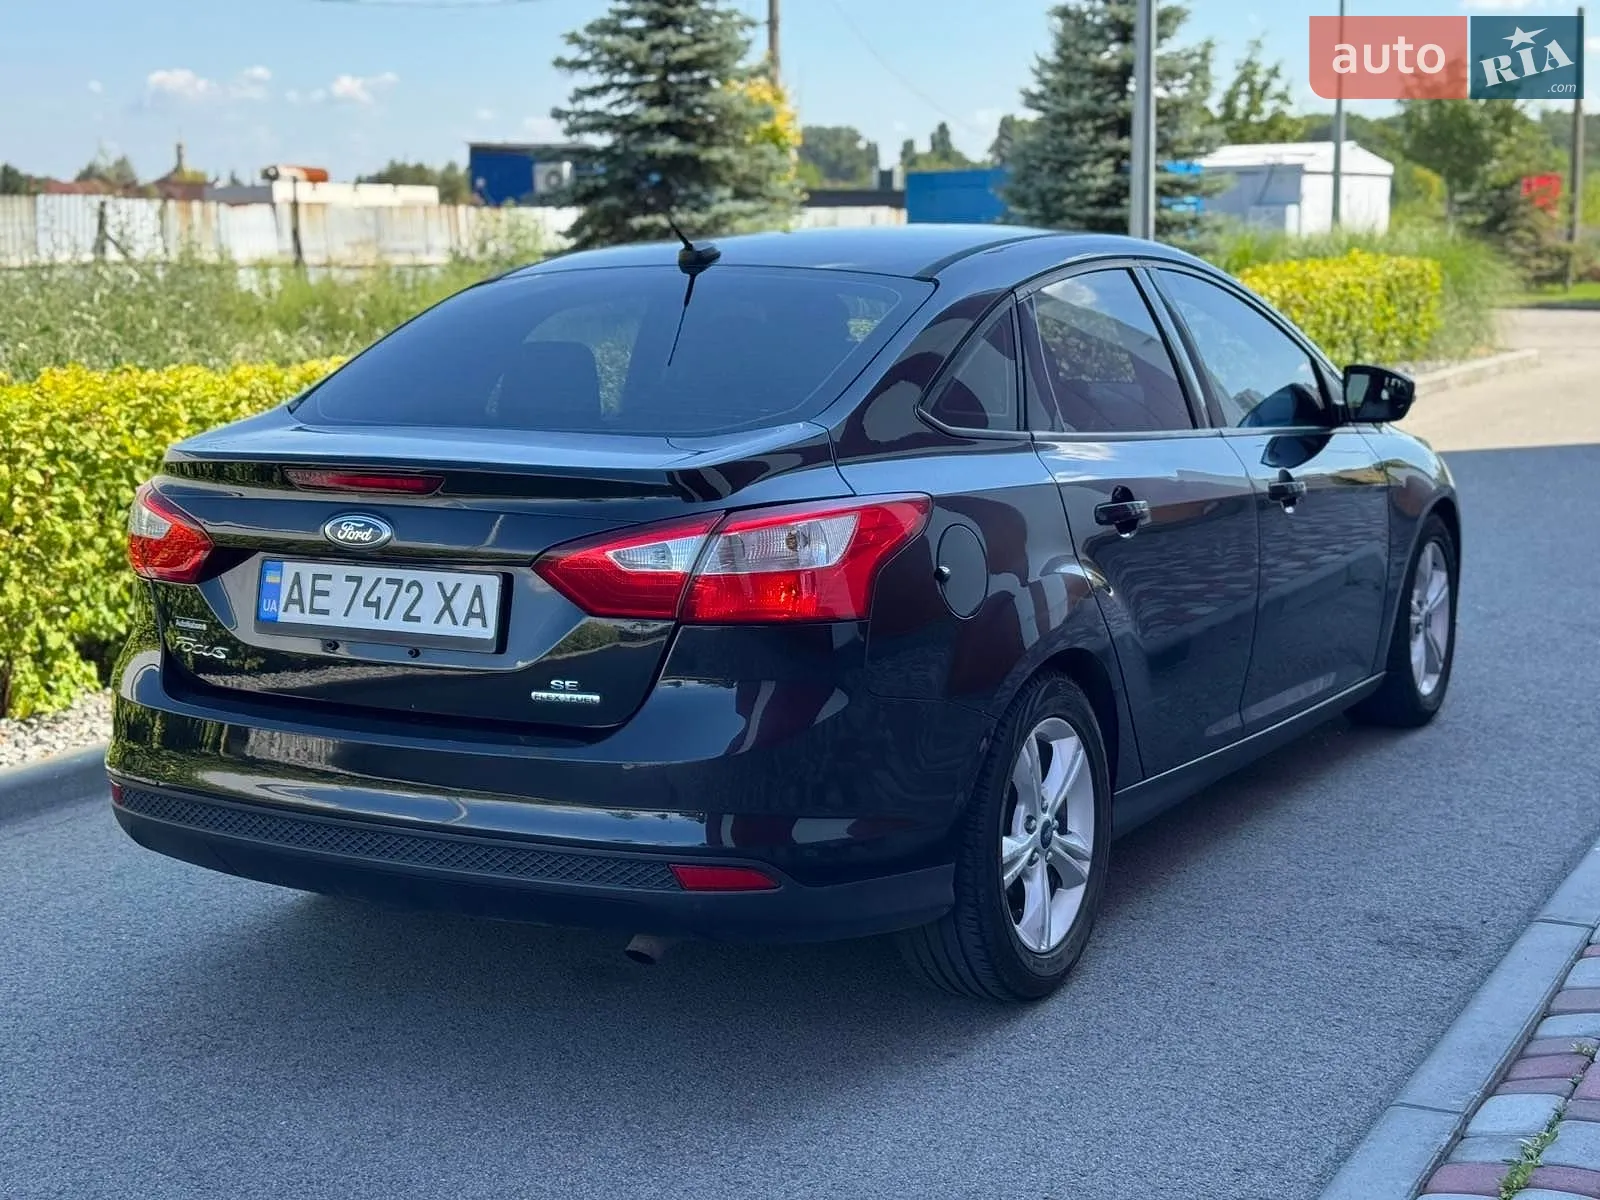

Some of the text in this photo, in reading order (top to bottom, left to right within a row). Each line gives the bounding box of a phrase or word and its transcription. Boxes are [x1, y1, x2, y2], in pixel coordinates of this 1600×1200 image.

[337, 521, 374, 542] Ford
[262, 599, 278, 613] UA
[282, 571, 488, 629] AE 7472 XA
[550, 679, 579, 691] SE
